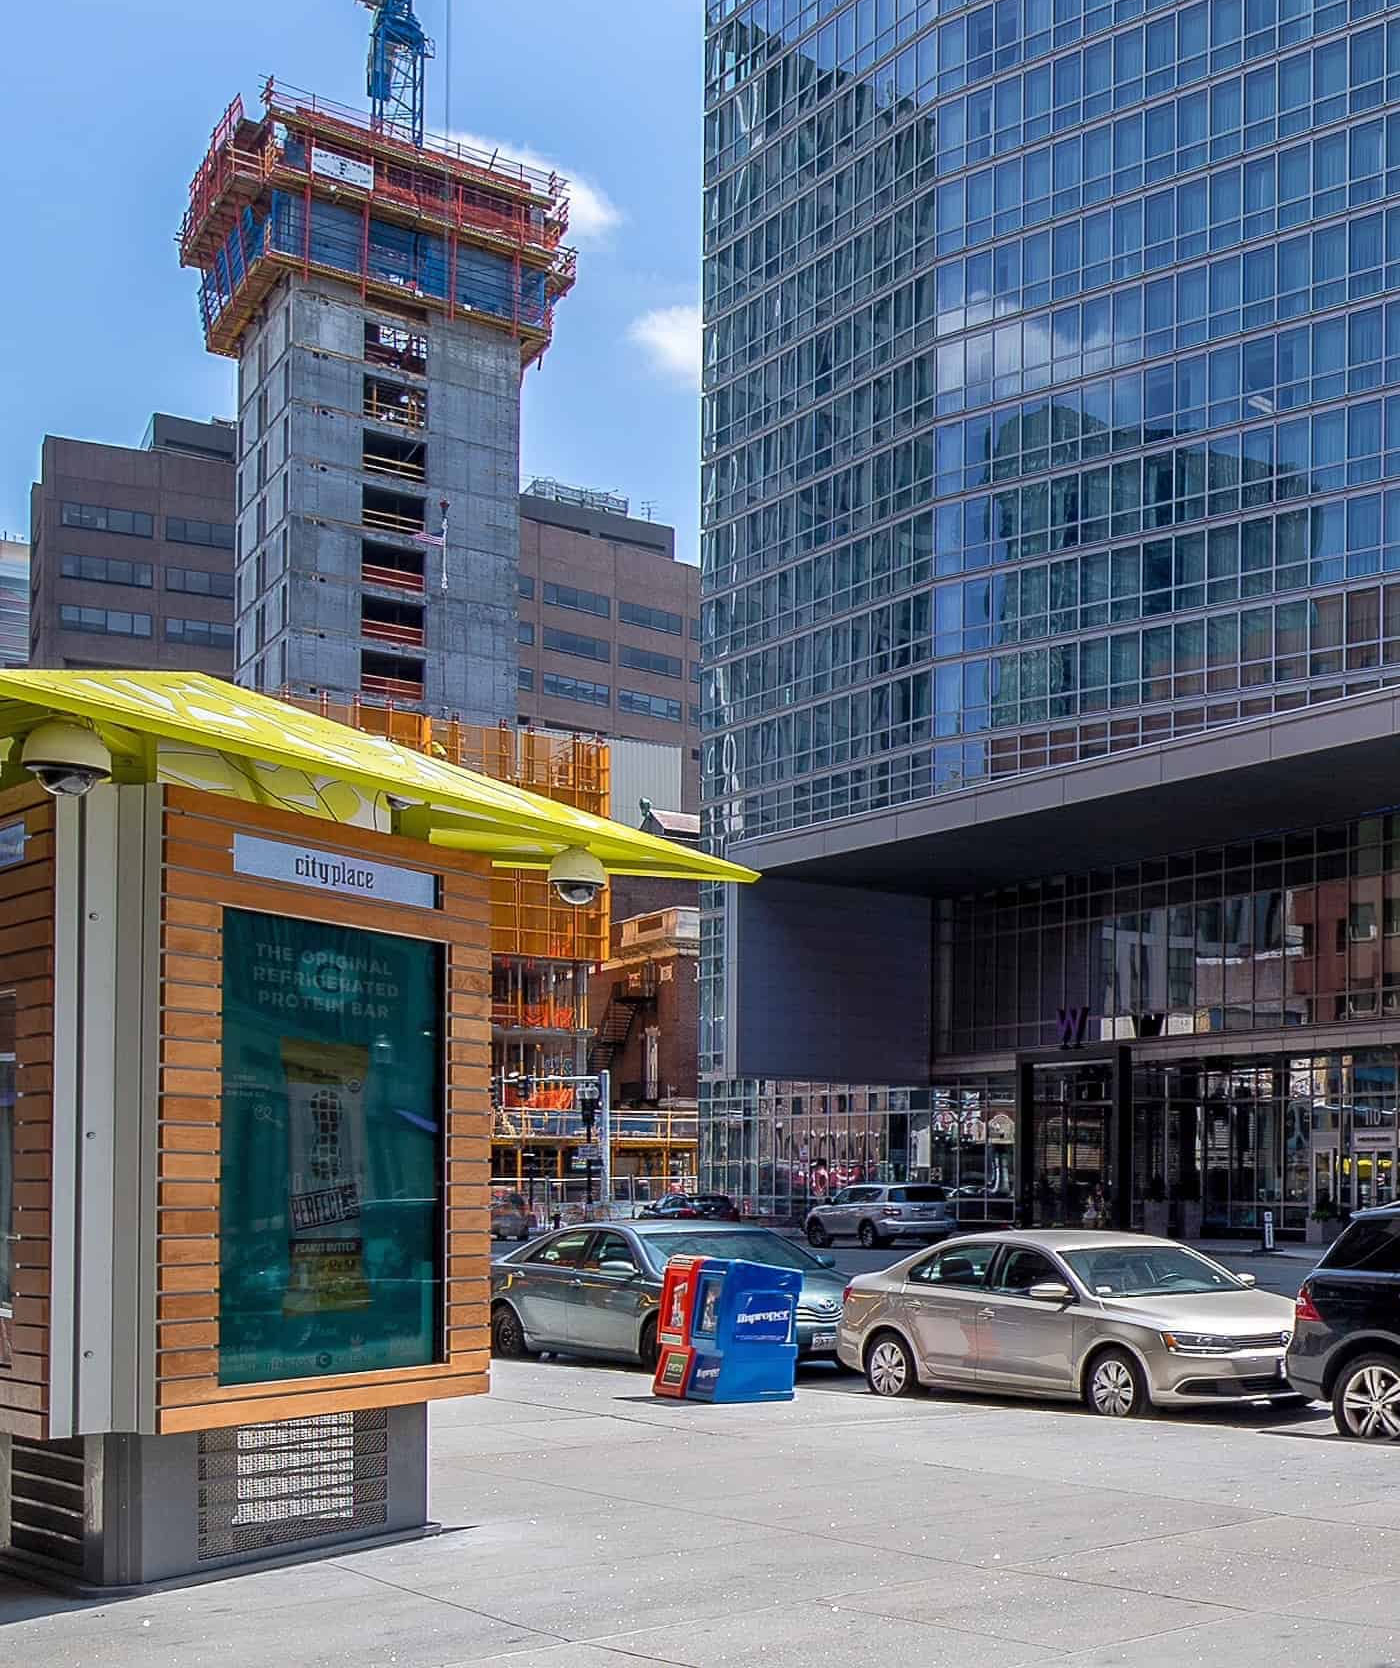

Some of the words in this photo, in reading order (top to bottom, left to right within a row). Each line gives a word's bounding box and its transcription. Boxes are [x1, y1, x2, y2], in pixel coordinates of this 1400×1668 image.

[295, 855, 374, 889] cityplace
[255, 942, 295, 962] THE
[258, 989, 345, 1014] PROTEIN
[351, 1001, 390, 1020] BAR
[1057, 1006, 1089, 1048] W
